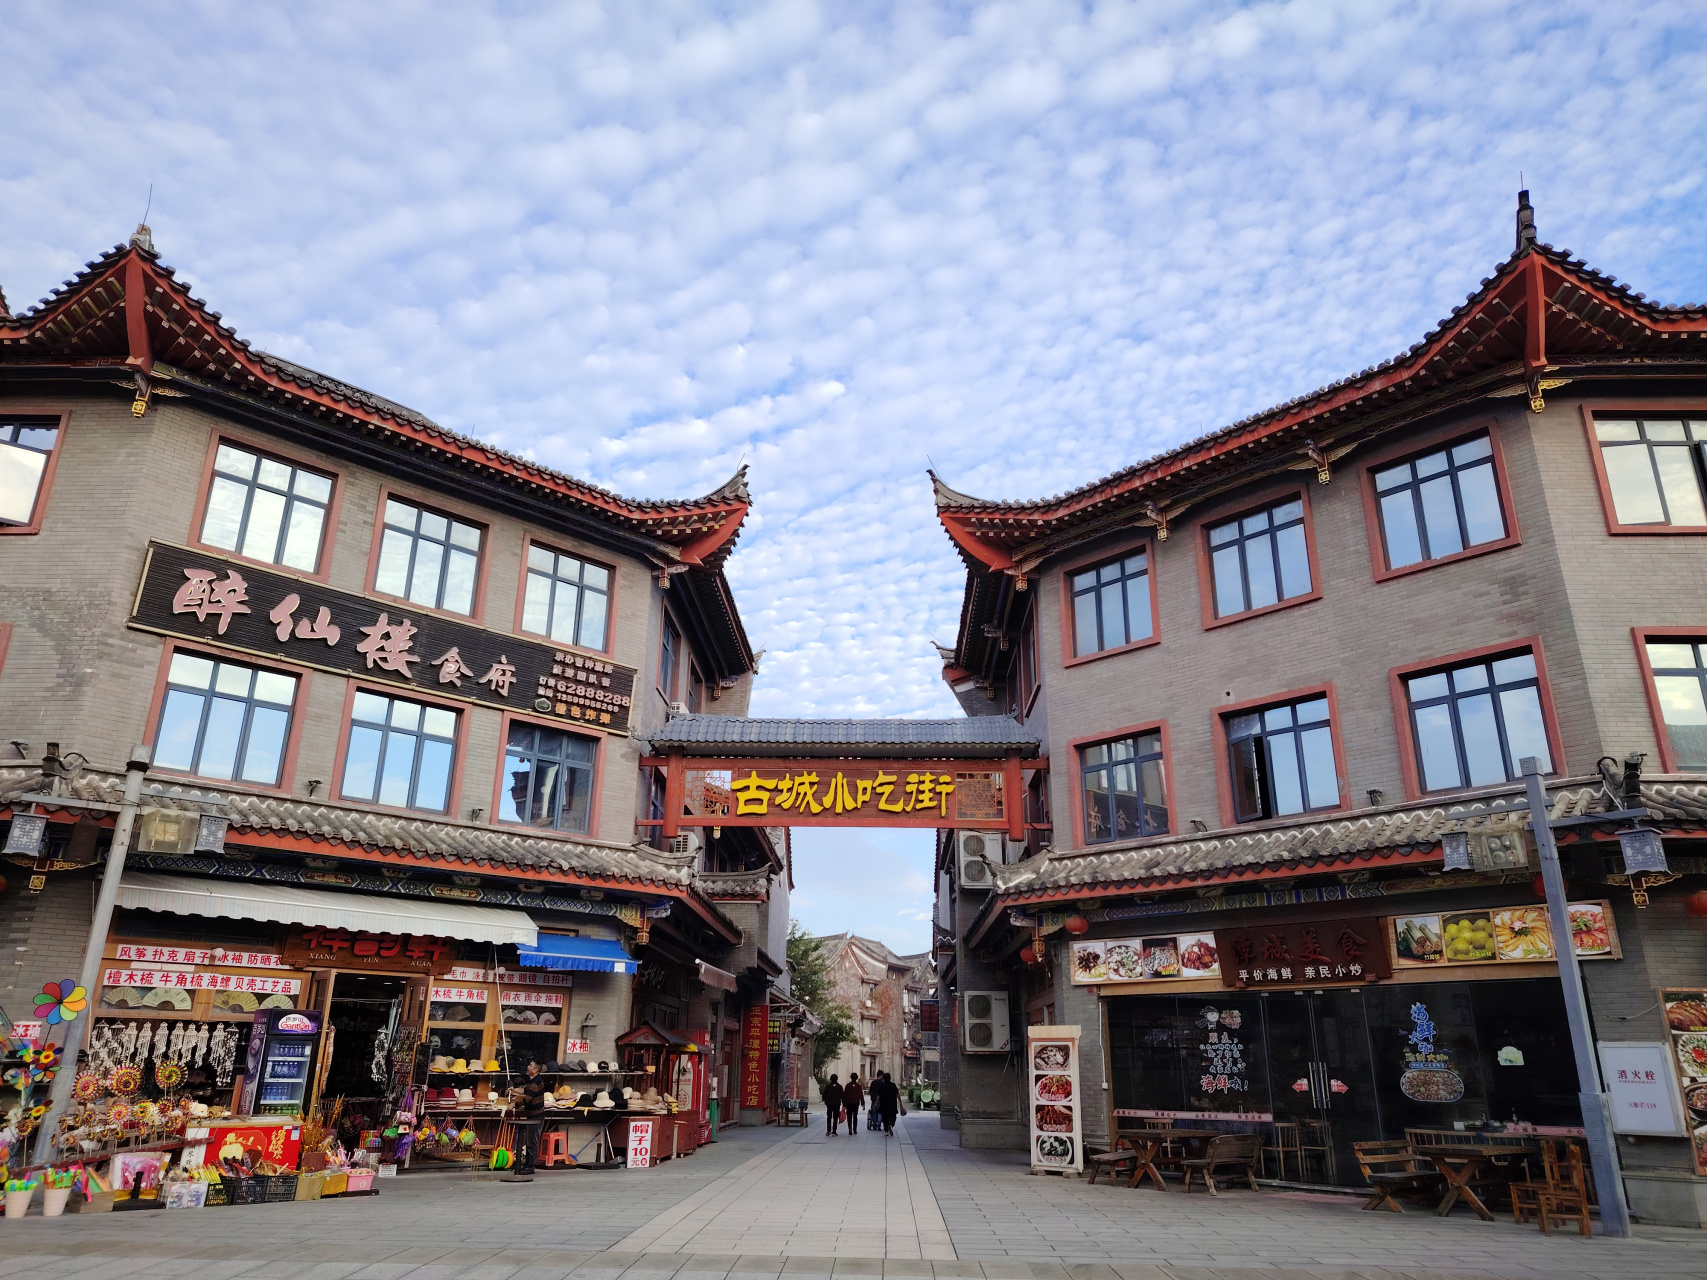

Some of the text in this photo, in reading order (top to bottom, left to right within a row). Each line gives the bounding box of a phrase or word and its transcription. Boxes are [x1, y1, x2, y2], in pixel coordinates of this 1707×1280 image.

[556, 680, 631, 708] 62888288
[731, 770, 956, 817] 古城小吃街
[119, 946, 211, 964] 风筝 扑克 扇子
[217, 951, 243, 964] 冰袖
[308, 953, 337, 961] XIANG
[449, 969, 467, 979] 毛巾
[1238, 962, 1363, 982] 平价海鲜 亲民小炒
[106, 970, 154, 986] 檀木梳
[158, 972, 203, 988] 牛角梳
[207, 974, 231, 990] 海螺
[234, 977, 292, 994] 贝壳工艺品
[518, 973, 538, 984] 眼镜
[542, 974, 570, 985] 自拍杆
[455, 989, 486, 1001] 牛角梳
[502, 991, 563, 1005] 雨衣 雨伞 拖鞋
[567, 1040, 589, 1053] 冰袖
[746, 1006, 762, 1106] 正宗平潭特色小吃店
[1617, 1069, 1656, 1081] 消火栓
[632, 1147, 649, 1157] 10
